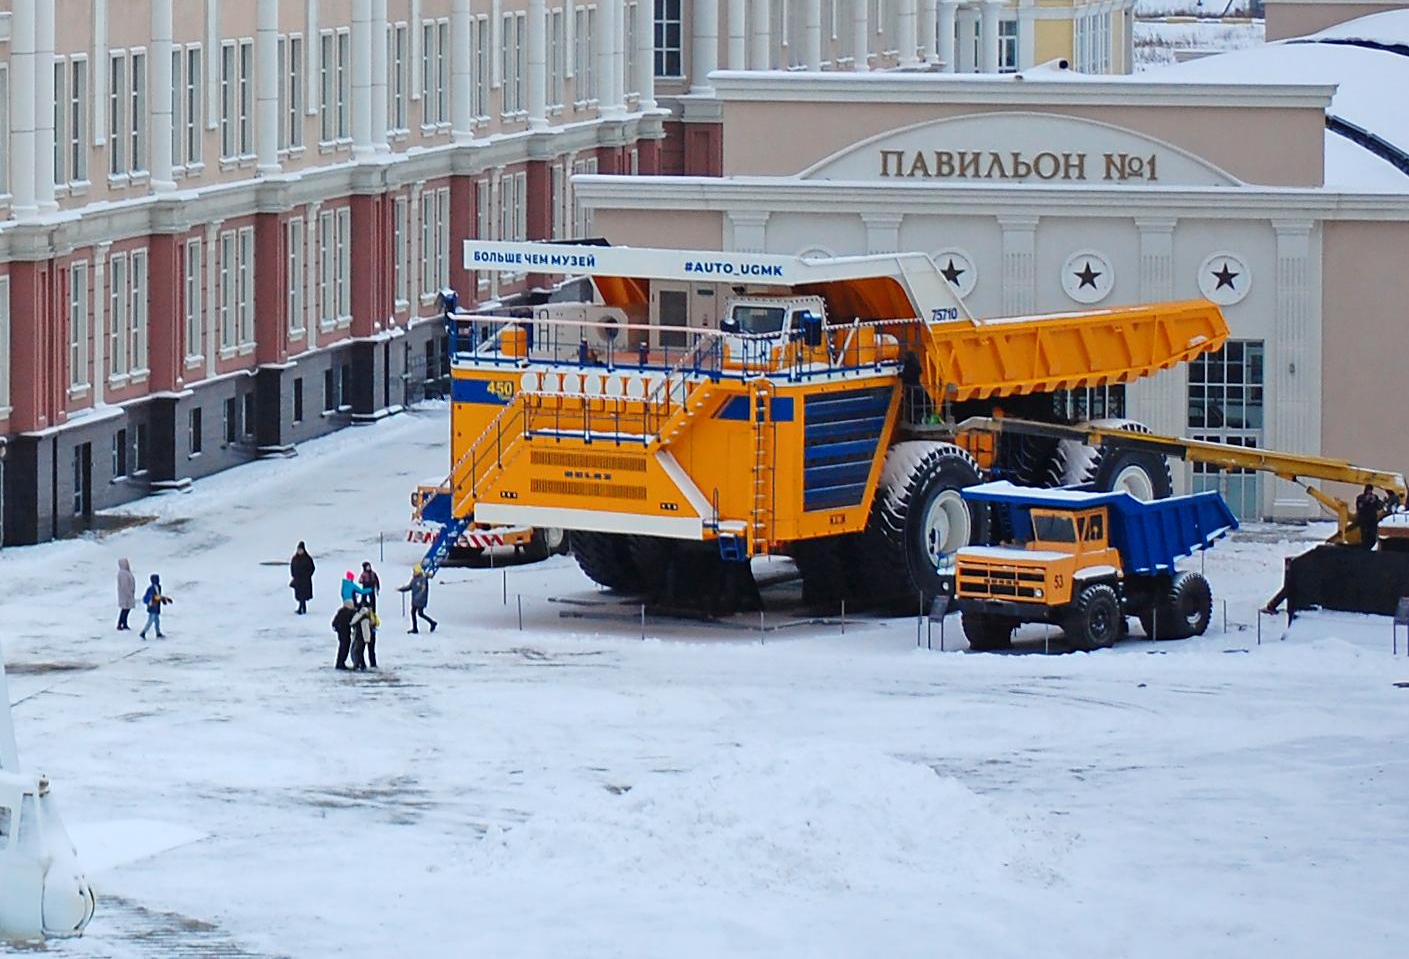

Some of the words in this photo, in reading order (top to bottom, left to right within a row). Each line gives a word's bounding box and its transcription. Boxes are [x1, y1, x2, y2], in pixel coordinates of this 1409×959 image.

[879, 149, 1087, 181] ПАВИЛЬОН
[473, 251, 522, 263] БОЛЬШЕ
[524, 254, 548, 264] ЧЕМ
[551, 254, 596, 267] МУЗЕЙ
[684, 261, 783, 277] #AUTO_UGMK
[931, 306, 958, 322] 75710
[486, 380, 513, 397] 450
[1053, 573, 1064, 589] 53
